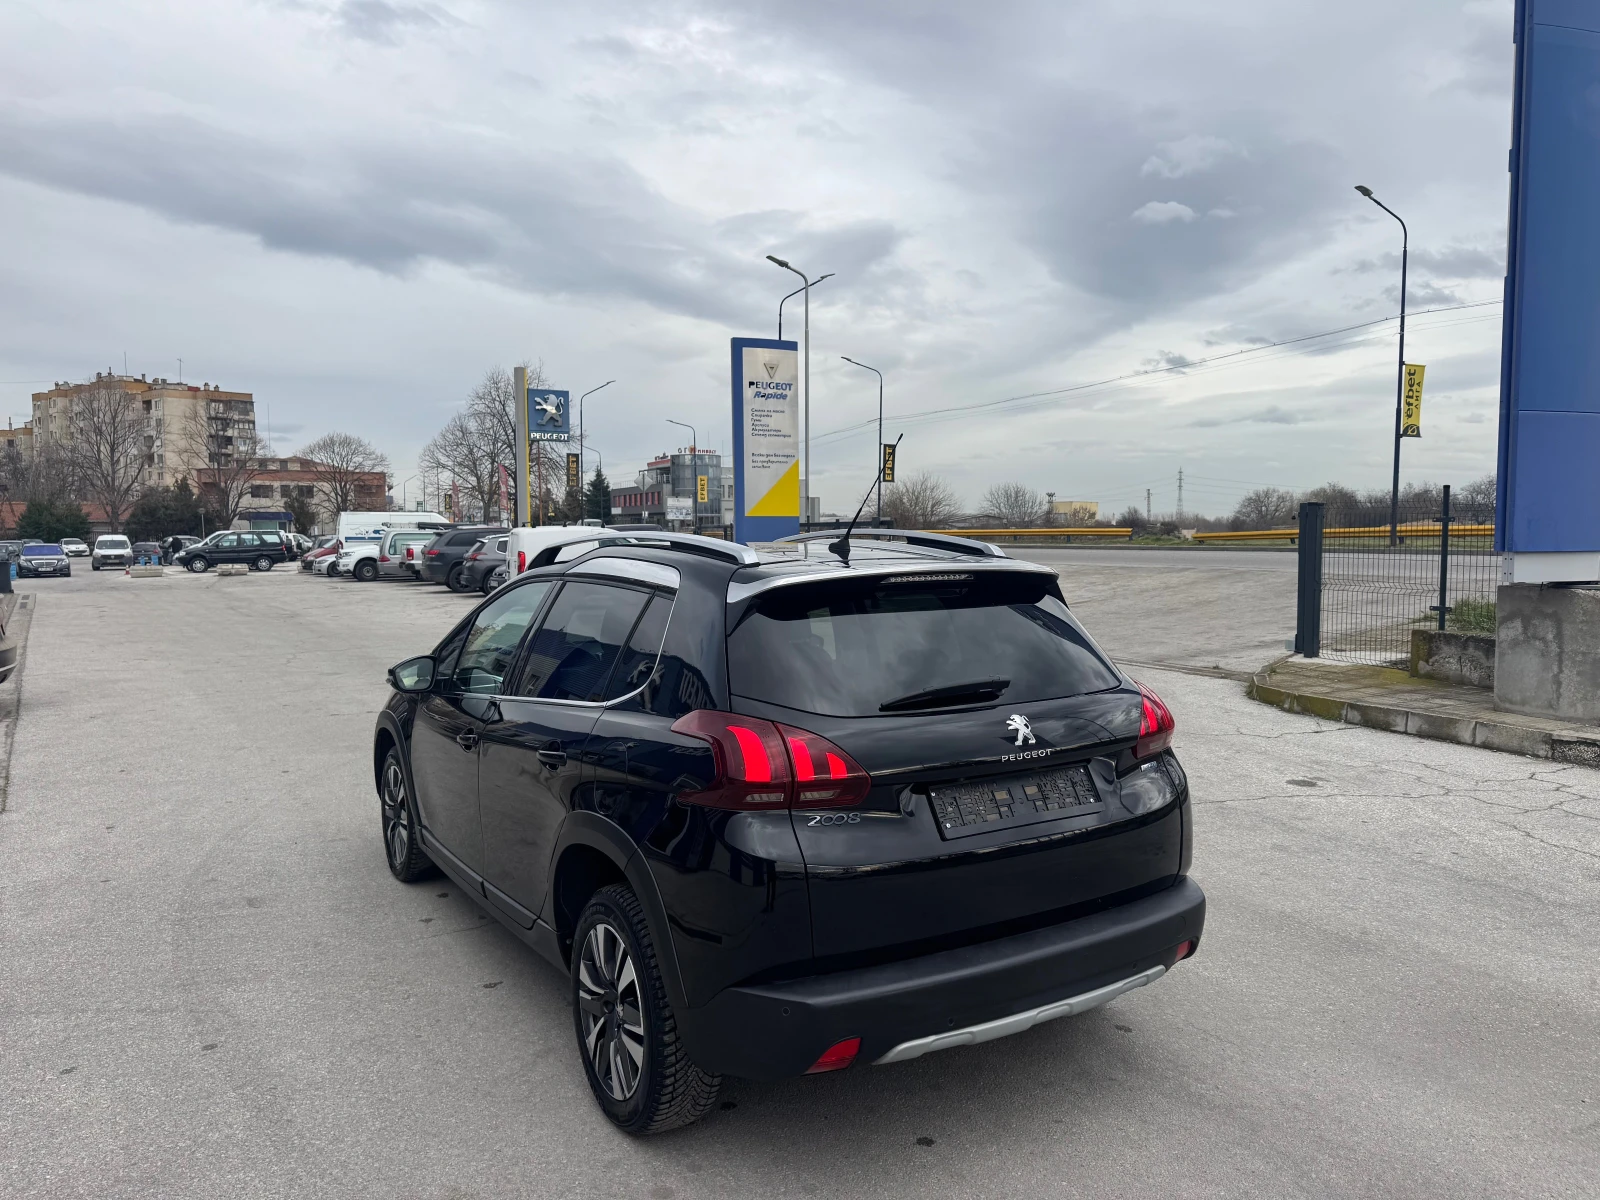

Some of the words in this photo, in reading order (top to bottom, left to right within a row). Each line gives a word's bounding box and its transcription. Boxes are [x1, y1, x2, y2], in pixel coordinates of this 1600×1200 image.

[748, 381, 793, 391] PEUGEOT
[753, 391, 788, 400] Rapide
[1405, 368, 1416, 419] efbet
[530, 432, 569, 441] PEUGEOT
[1001, 748, 1053, 762] PEUGEOT
[807, 812, 861, 827] 2008
